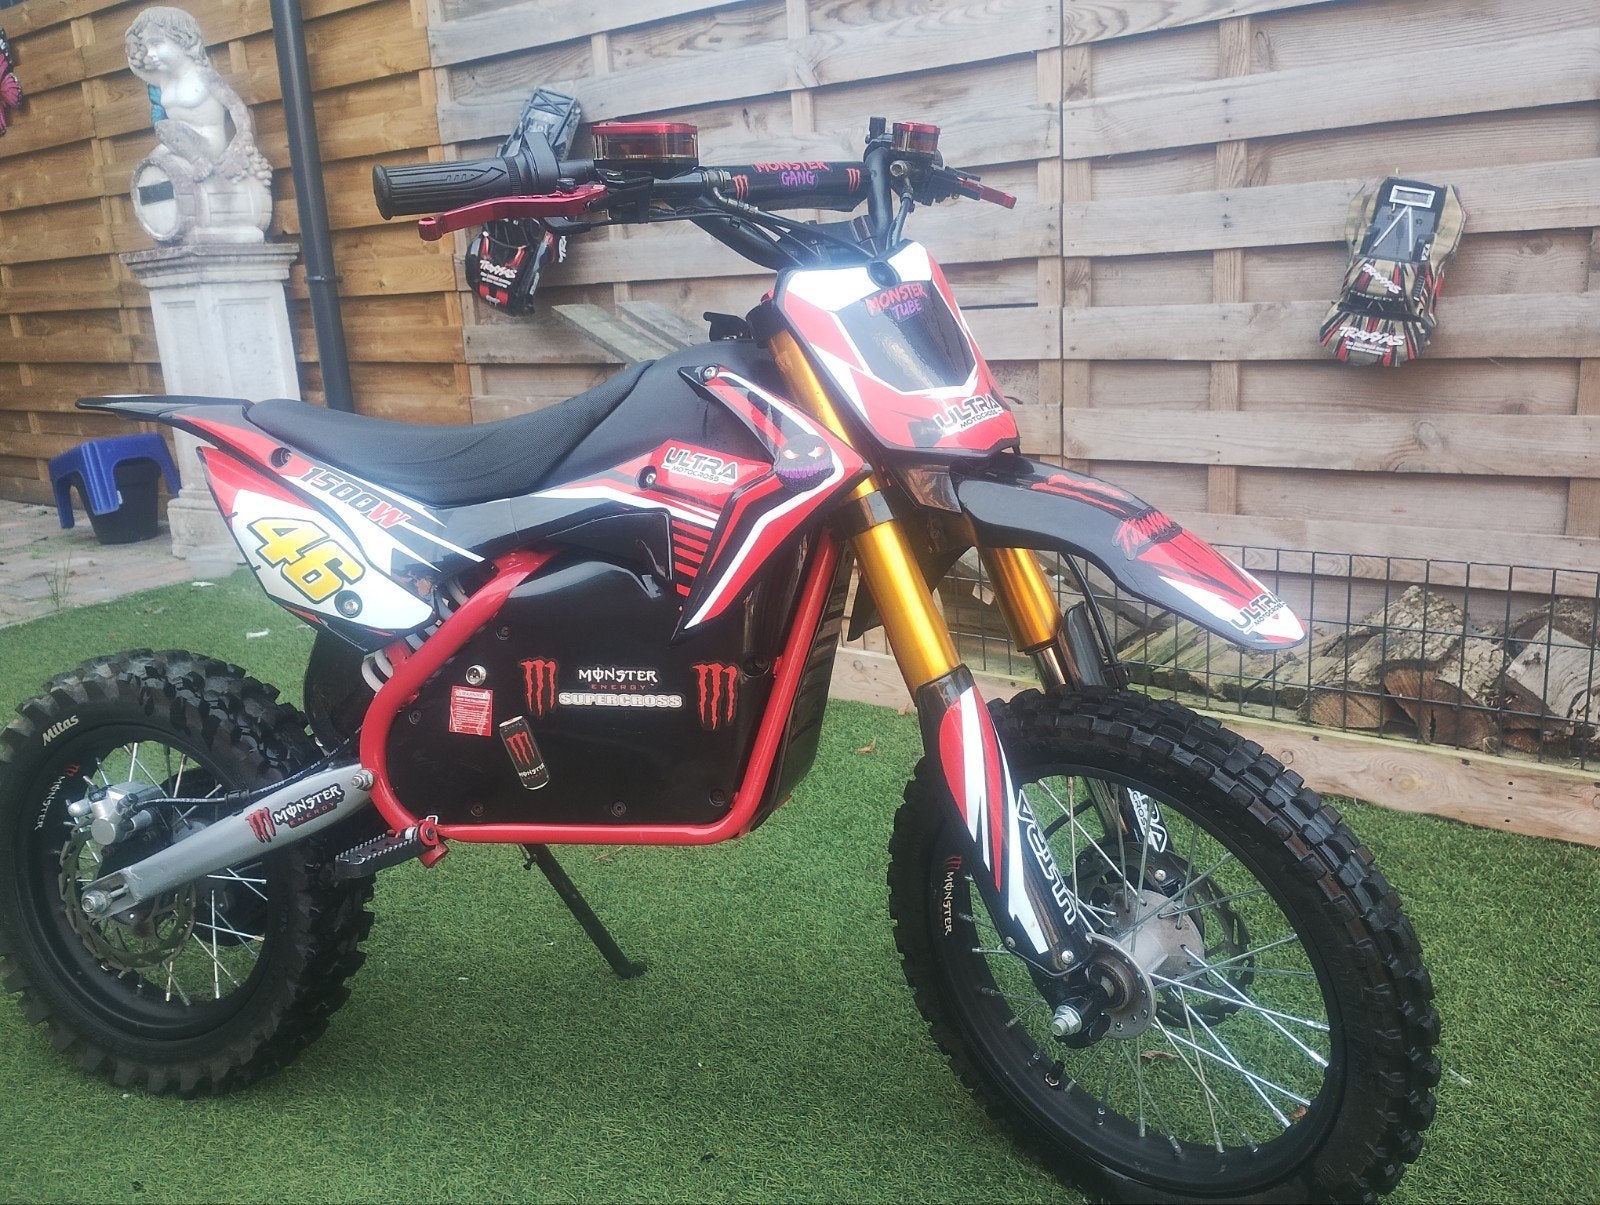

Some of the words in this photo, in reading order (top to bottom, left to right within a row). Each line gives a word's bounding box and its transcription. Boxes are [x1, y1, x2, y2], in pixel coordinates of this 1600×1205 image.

[752, 161, 830, 173] MONSTER
[781, 170, 815, 187] GANG
[866, 282, 928, 316] MONSTER
[892, 299, 922, 320] TUBE
[933, 393, 1002, 430] ULTRA
[665, 447, 737, 481] ULTRA
[671, 465, 721, 483] MOTOCROSS
[300, 467, 412, 529] 1500W
[246, 516, 366, 605] 46
[578, 666, 658, 686] MONSTER
[591, 683, 648, 691] ENERGY
[558, 692, 683, 708] SUPERCROSS
[42, 715, 80, 747] Mitas
[273, 785, 342, 824] MONSTER
[1016, 788, 1077, 925] ULTRA
[942, 871, 955, 936] MONSTER
